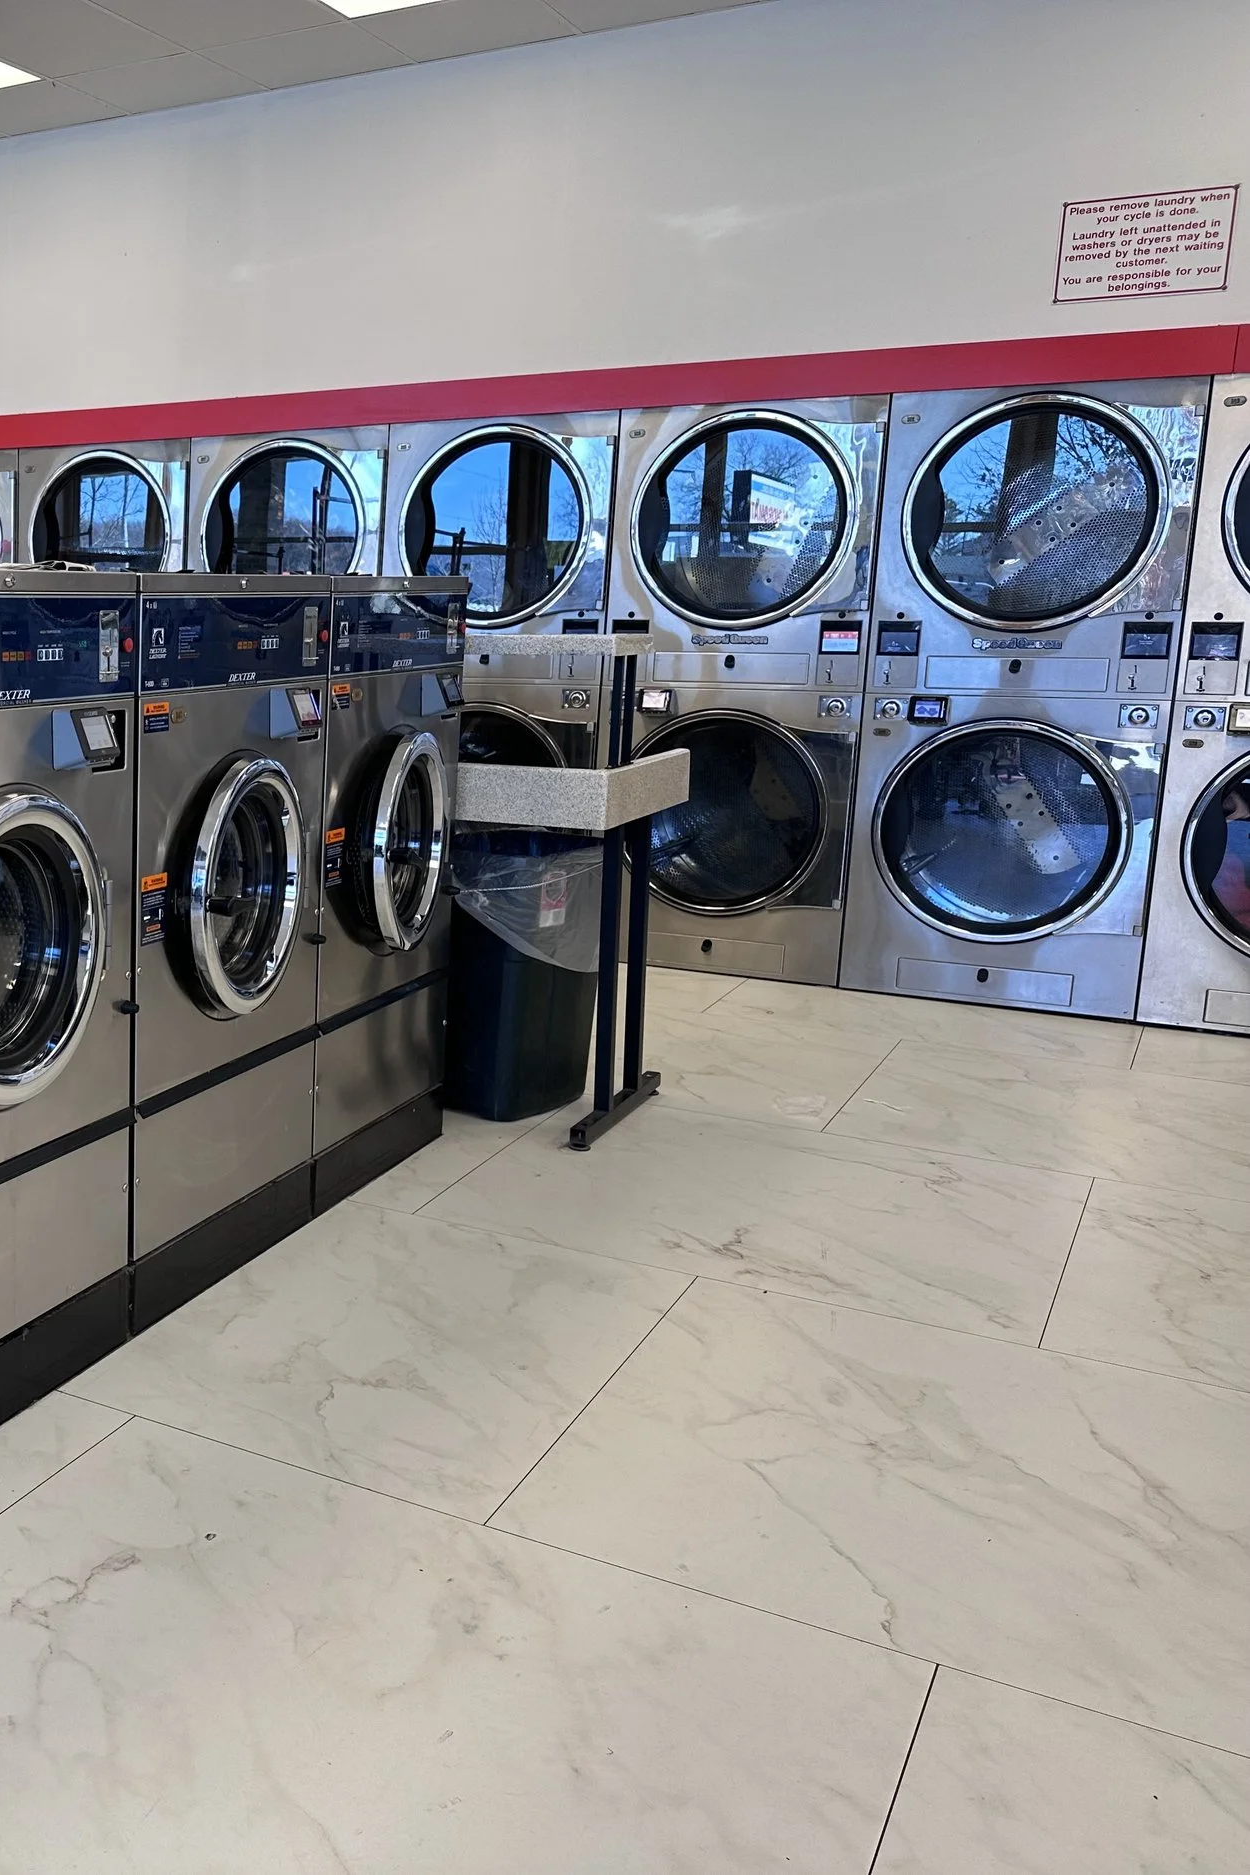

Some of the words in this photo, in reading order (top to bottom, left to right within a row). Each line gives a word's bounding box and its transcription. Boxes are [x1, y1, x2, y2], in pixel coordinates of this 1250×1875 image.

[1070, 206, 1105, 215] Please
[1110, 202, 1150, 211] remove
[1155, 196, 1195, 207] laundry
[1200, 193, 1230, 202] when
[1096, 215, 1119, 225] your
[1124, 211, 1152, 221] cycle
[1156, 209, 1164, 218] is
[1170, 207, 1199, 217] done.
[1073, 230, 1115, 241] Laundry
[1120, 226, 1138, 236] left
[1143, 221, 1206, 234] unattended
[1211, 219, 1221, 227] in
[1072, 241, 1116, 251] washers
[1137, 236, 1172, 246] dryers
[1177, 234, 1200, 243] may
[1205, 230, 1219, 238] be
[1065, 251, 1111, 262] removed
[1115, 249, 1128, 258] by
[1134, 247, 1150, 256] the
[1155, 245, 1179, 254] next
[1184, 241, 1224, 251] waiting
[1116, 258, 1167, 268] customer.
[1063, 276, 1081, 285] You
[1086, 275, 1103, 284] are
[1108, 269, 1171, 282] responsible
[1176, 267, 1191, 275] for
[1197, 265, 1222, 275] your
[1108, 280, 1170, 292] belongings.
[692, 634, 730, 646] Speed
[730, 634, 768, 644] Queen
[972, 637, 1017, 650] Speed
[1017, 637, 1062, 649] Queen
[392, 659, 412, 667] DEXTER
[229, 672, 256, 682] DEXTER
